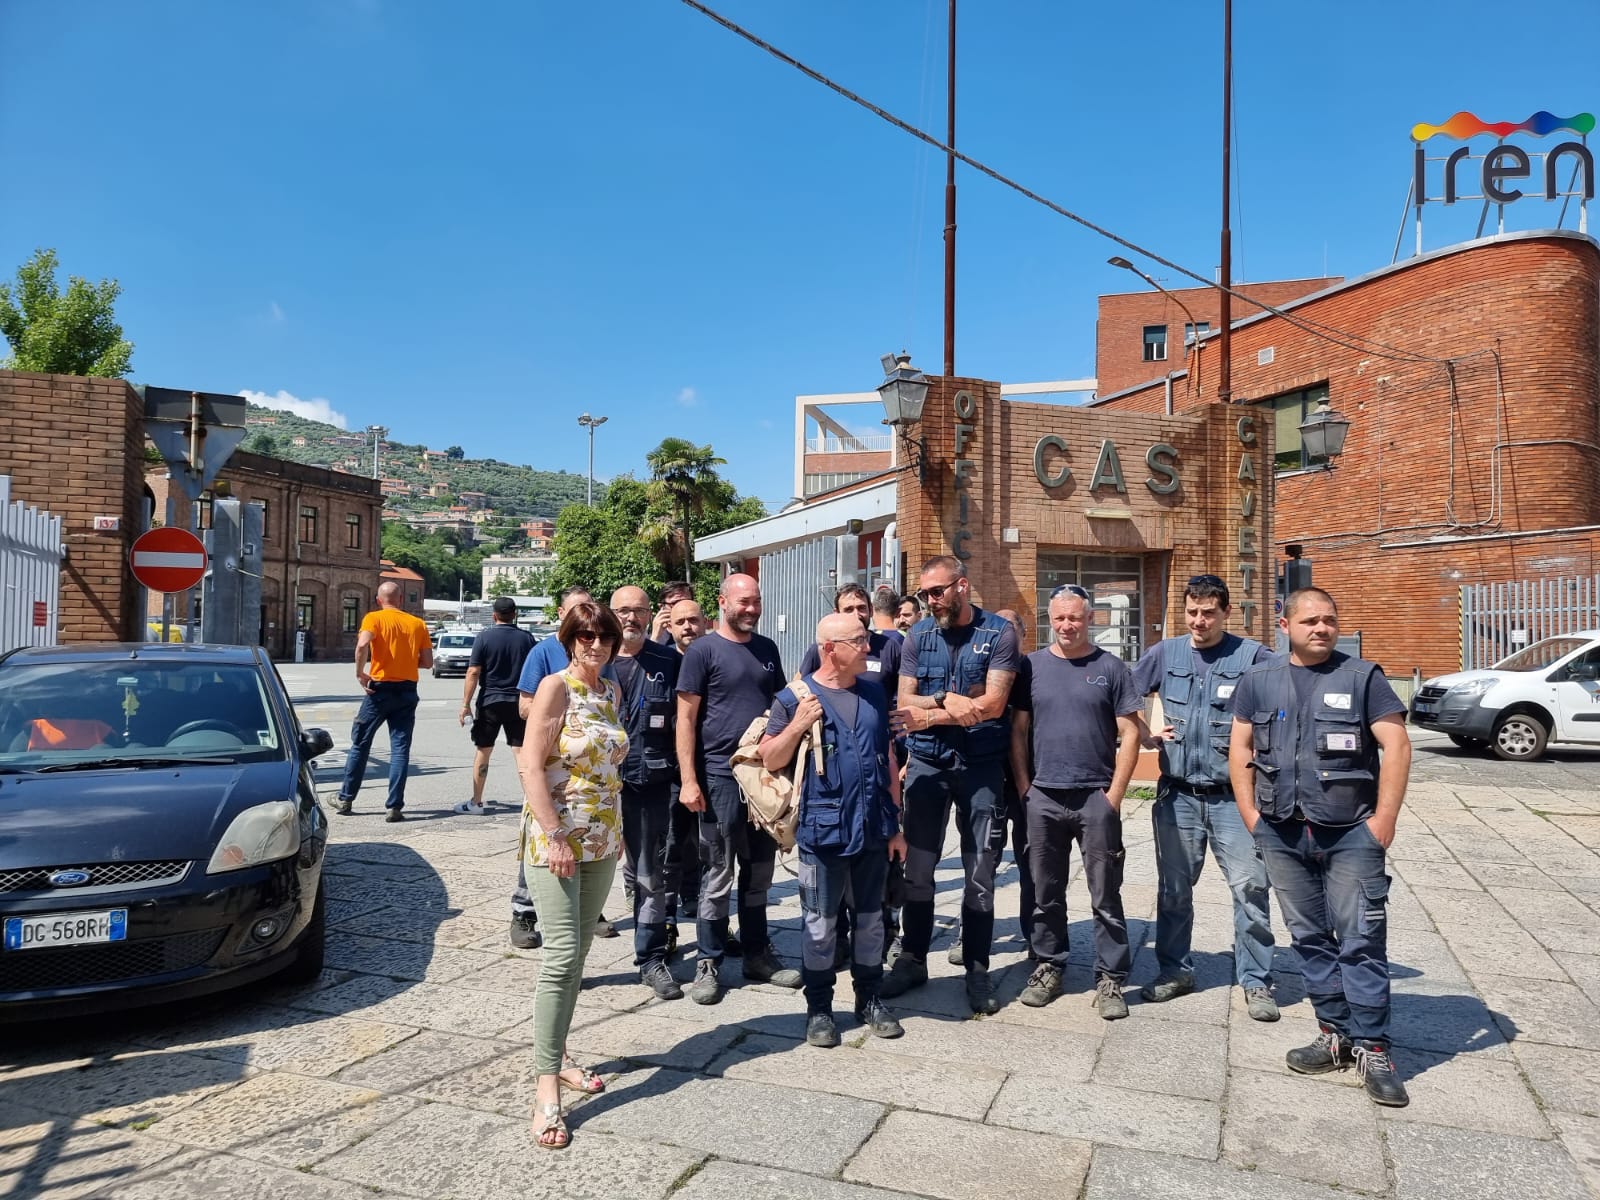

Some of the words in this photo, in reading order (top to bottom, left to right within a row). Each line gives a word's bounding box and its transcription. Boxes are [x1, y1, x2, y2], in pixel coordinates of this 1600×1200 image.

[1414, 142, 1595, 206] iren
[1034, 434, 1180, 494] CAS
[1237, 415, 1255, 628] CAVETT
[58, 873, 80, 883] Ford
